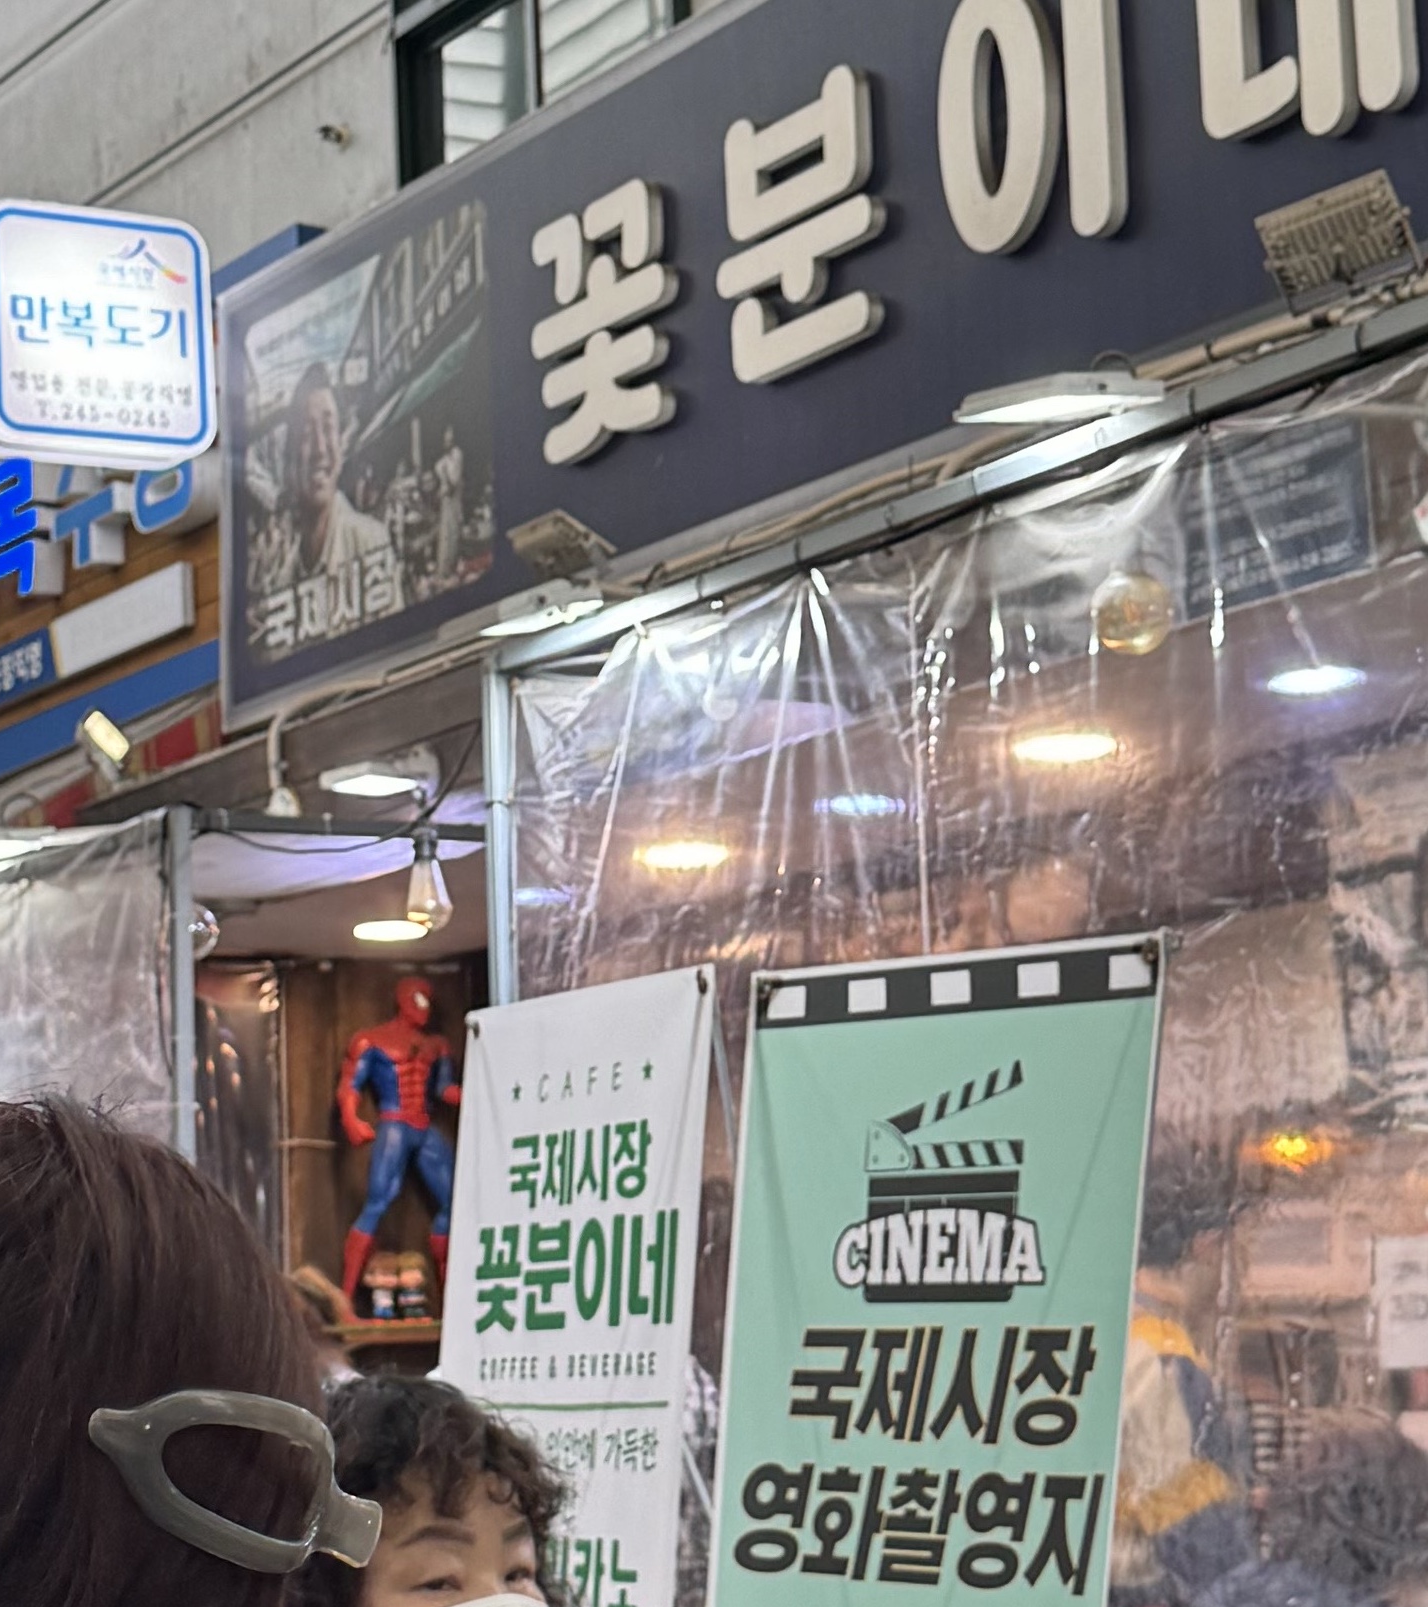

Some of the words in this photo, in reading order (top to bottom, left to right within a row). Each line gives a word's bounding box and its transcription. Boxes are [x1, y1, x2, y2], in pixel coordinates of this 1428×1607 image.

[9, 294, 188, 358] 만복도기
[537, 1061, 623, 1103] CAFE
[509, 1118, 652, 1208] 국제시장
[475, 1208, 679, 1334] 꽃분이네
[835, 1208, 1045, 1285] CINEMA
[479, 1356, 538, 1381] COFFEE
[567, 1351, 657, 1379] BEVERAGE
[789, 1326, 1097, 1446] 국제시장
[603, 1427, 660, 1472] 가득한
[734, 1462, 1105, 1597] 영화촬영지
